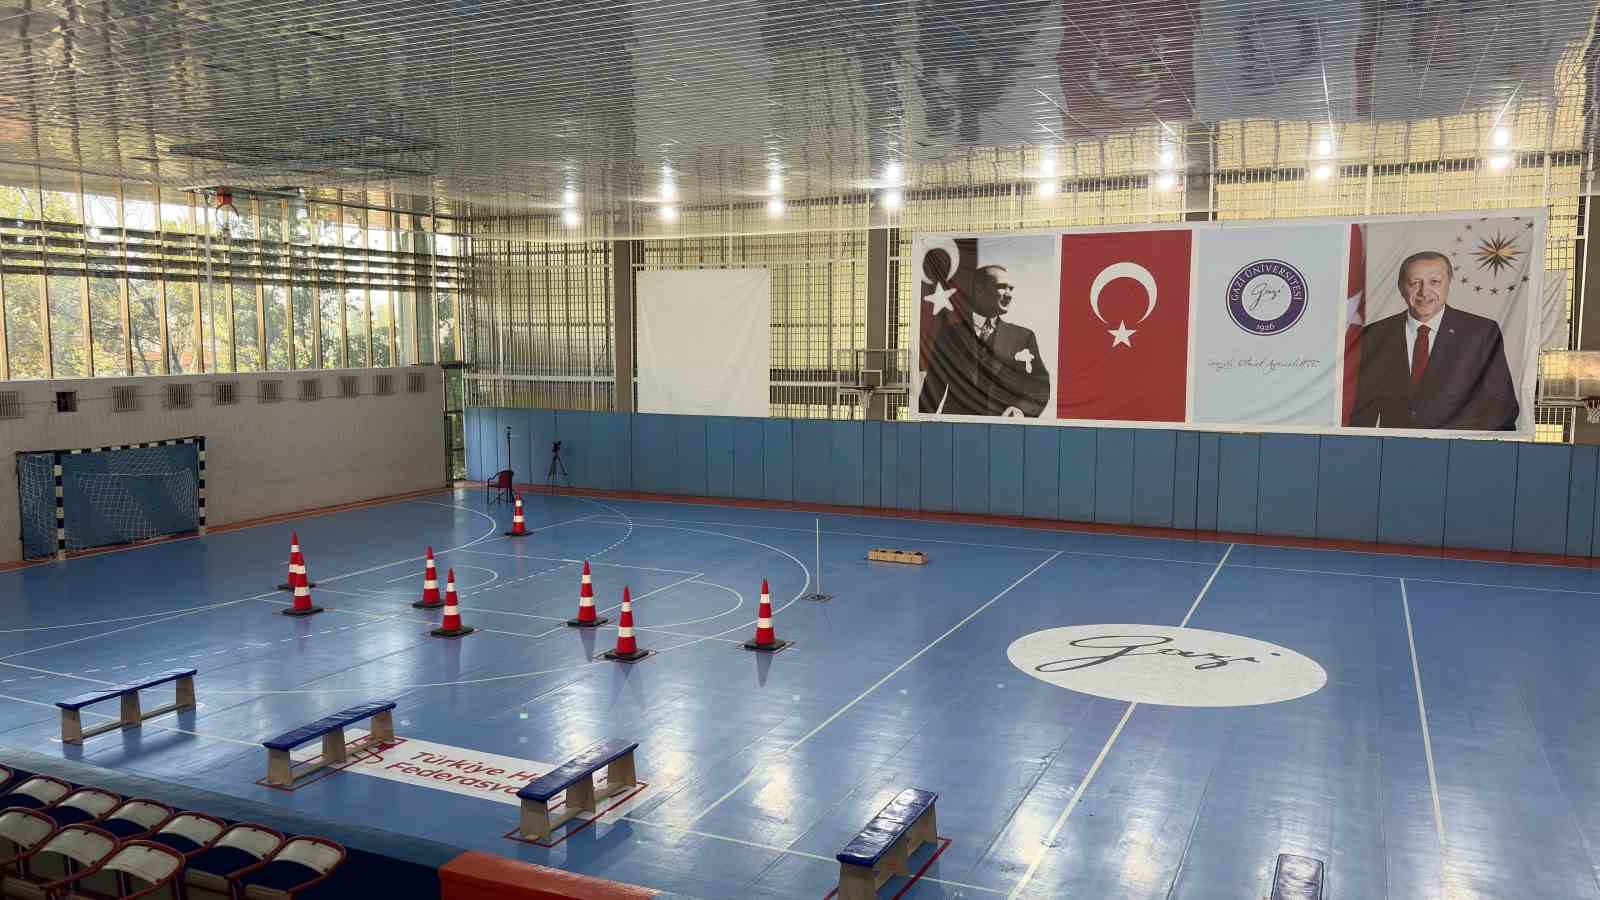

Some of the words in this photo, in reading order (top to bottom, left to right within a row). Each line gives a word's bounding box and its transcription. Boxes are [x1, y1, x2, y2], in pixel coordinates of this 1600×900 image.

[1035, 635, 1280, 672] Gazi
[386, 762, 520, 795] Federasyo
[411, 751, 504, 776] Türkiye
